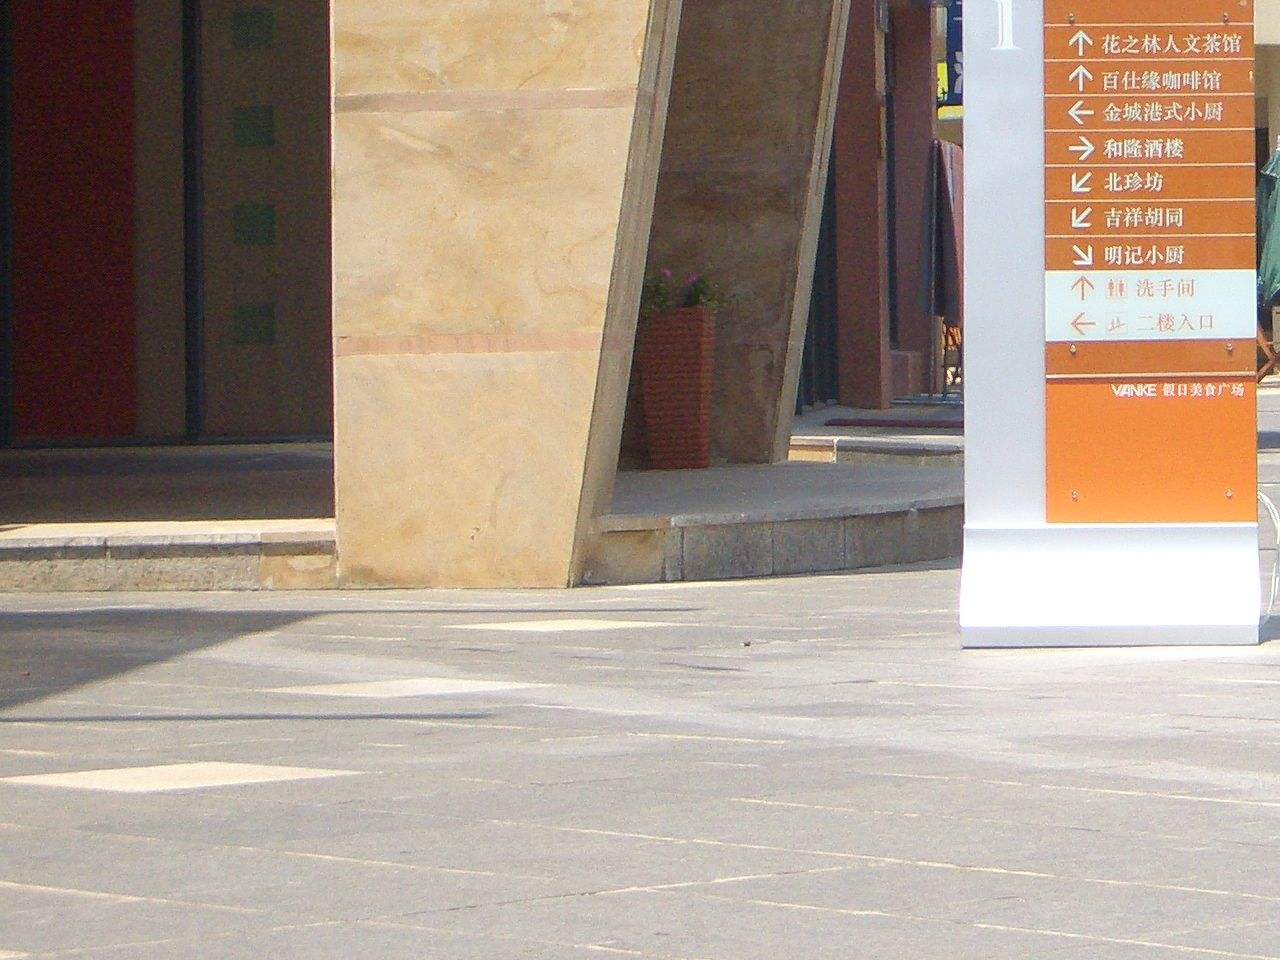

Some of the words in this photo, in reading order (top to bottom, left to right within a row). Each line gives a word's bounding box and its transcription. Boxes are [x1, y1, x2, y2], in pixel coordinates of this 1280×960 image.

[1101, 33, 1242, 54] 花之林人文茶馆
[1102, 70, 1222, 90] 百仕缘咖啡馆
[1103, 138, 1184, 159] 和隆酒楼
[1104, 172, 1164, 192] 北珍坊
[1104, 208, 1184, 228] 吉祥胡同
[1104, 245, 1184, 266] 明记小厨
[1136, 278, 1195, 298] 洗手间
[1136, 312, 1214, 332] 二楼入口
[1111, 383, 1157, 398] VANKE
[1163, 382, 1245, 398] 假日美食广场
